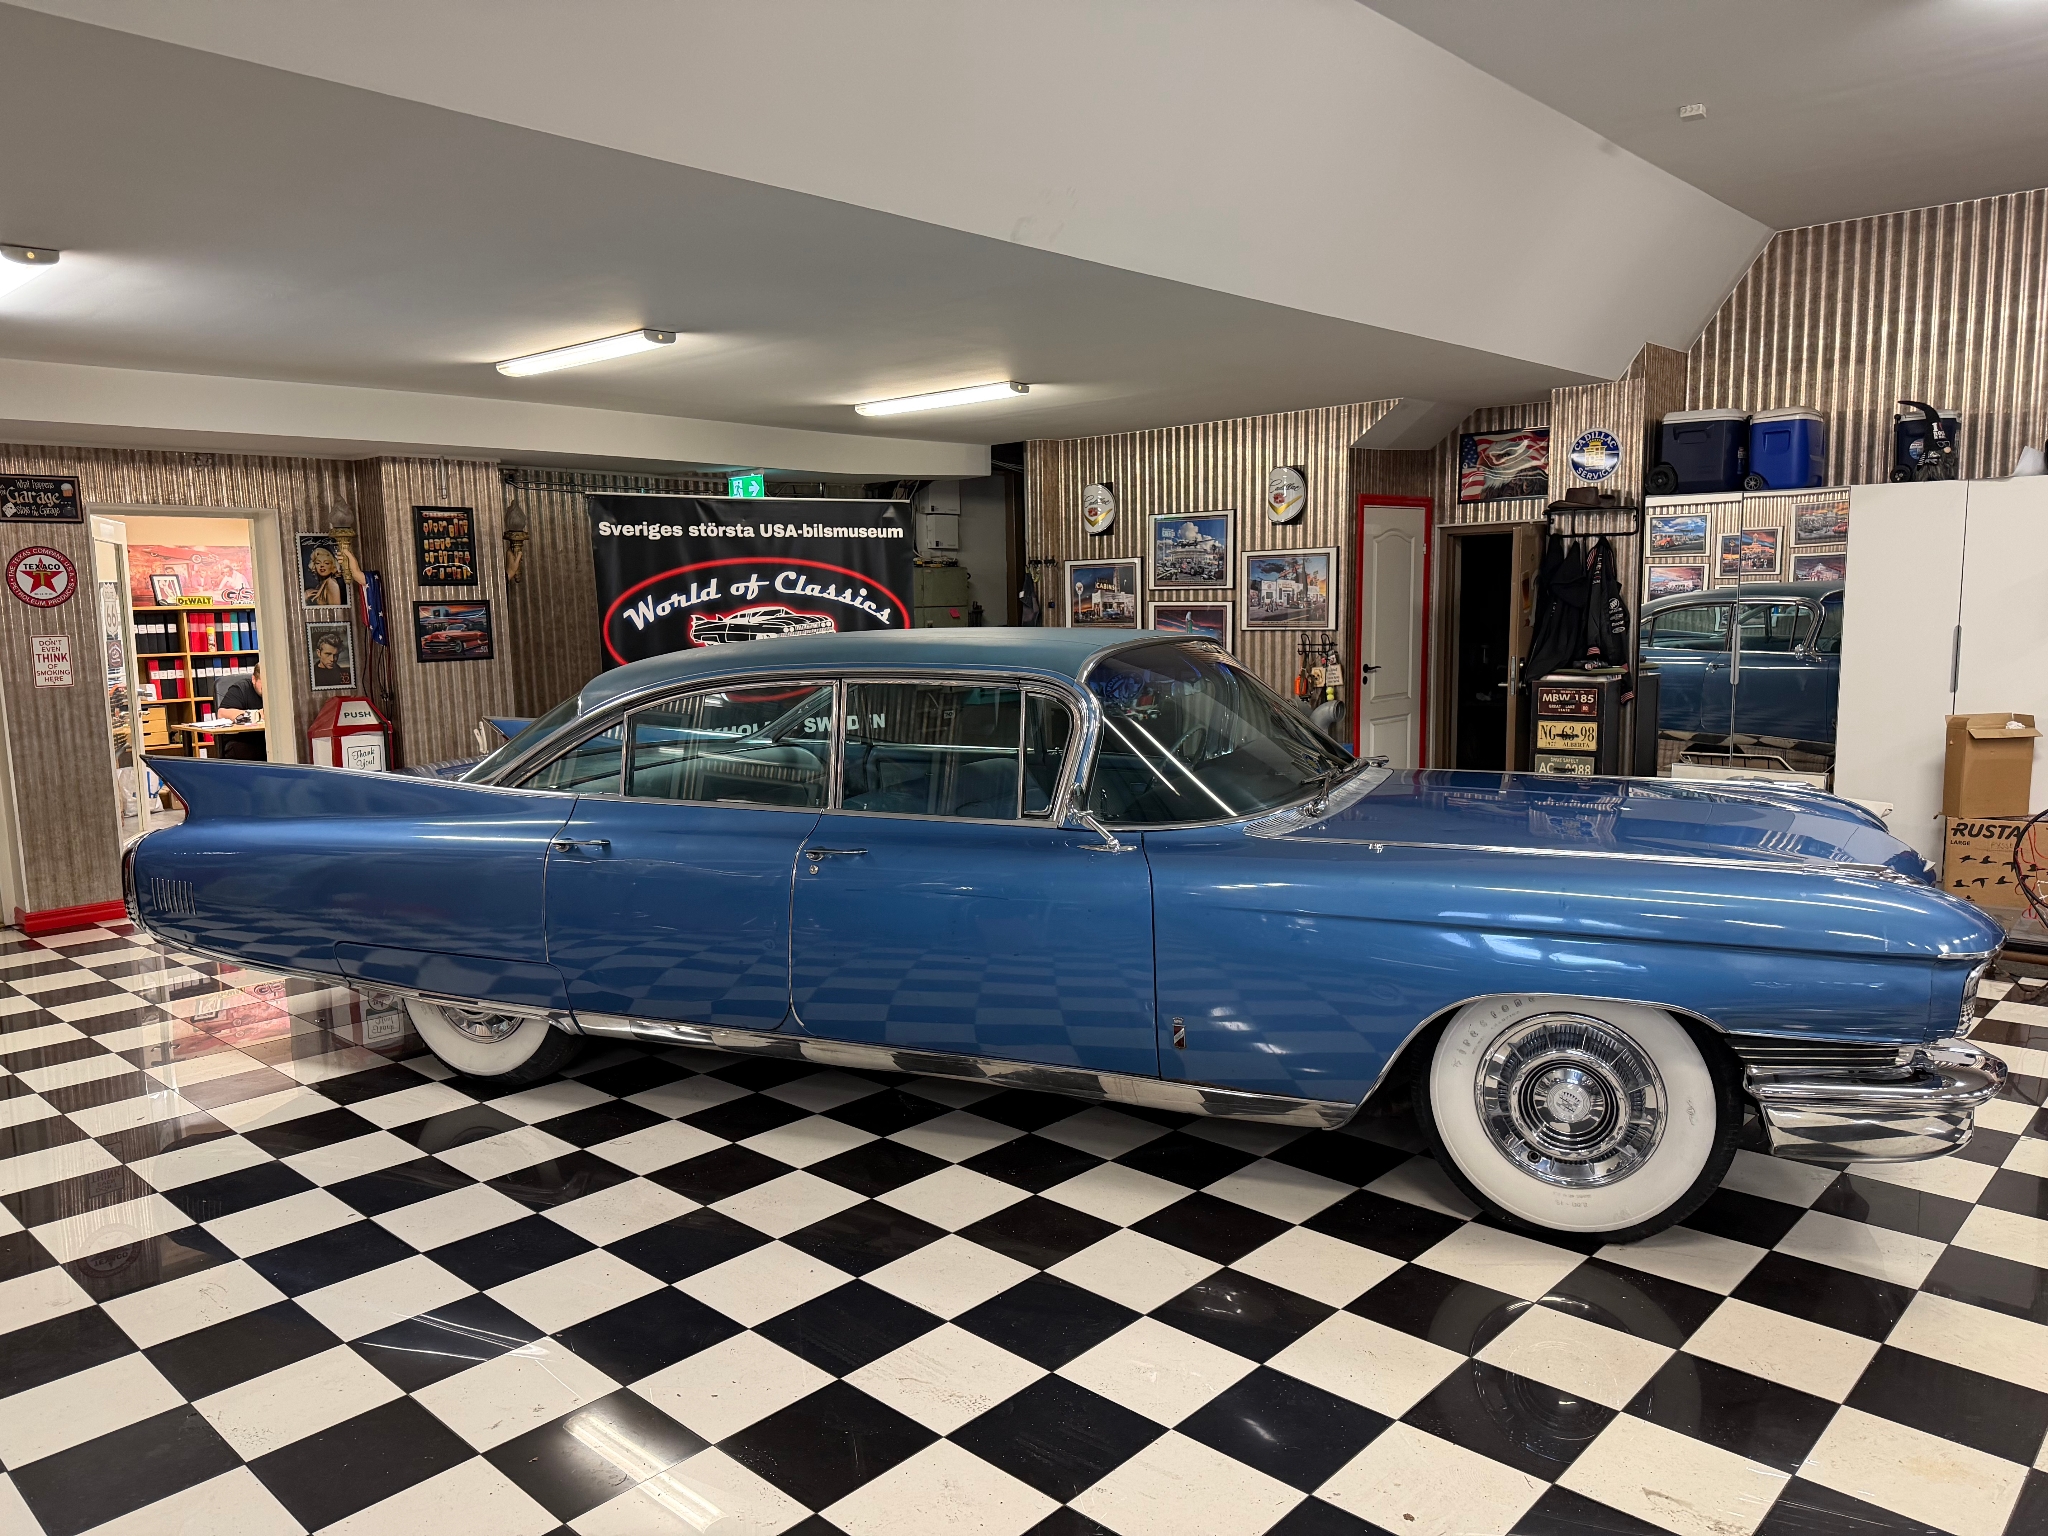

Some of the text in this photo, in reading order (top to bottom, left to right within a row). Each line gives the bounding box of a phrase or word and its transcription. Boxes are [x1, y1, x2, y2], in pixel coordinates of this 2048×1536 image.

[1574, 431, 1617, 450] CADILLAC
[1576, 465, 1613, 480] SERVICE
[15, 479, 55, 489] What happens
[39, 504, 60, 516] Garage
[598, 521, 904, 540] Sveriges största USA-bilsmuseum
[12, 550, 31, 564] TEXAS
[33, 548, 64, 561] COMPANY
[1096, 582, 1115, 590] CABINS
[11, 582, 75, 606] PETROLEUM PRODUCTS
[622, 571, 891, 631] World of Classics
[39, 639, 62, 647] DON'T
[35, 653, 69, 663] THINK
[36, 669, 71, 677] SMOKING
[1542, 693, 1594, 703] MBW 185
[343, 711, 372, 719] PUSH
[1539, 724, 1557, 741] NG
[1580, 725, 1595, 742] 98
[351, 747, 375, 761] Thank
[356, 755, 375, 770] You!
[1538, 761, 1555, 774] AC
[1951, 822, 2022, 840] RUSTA
